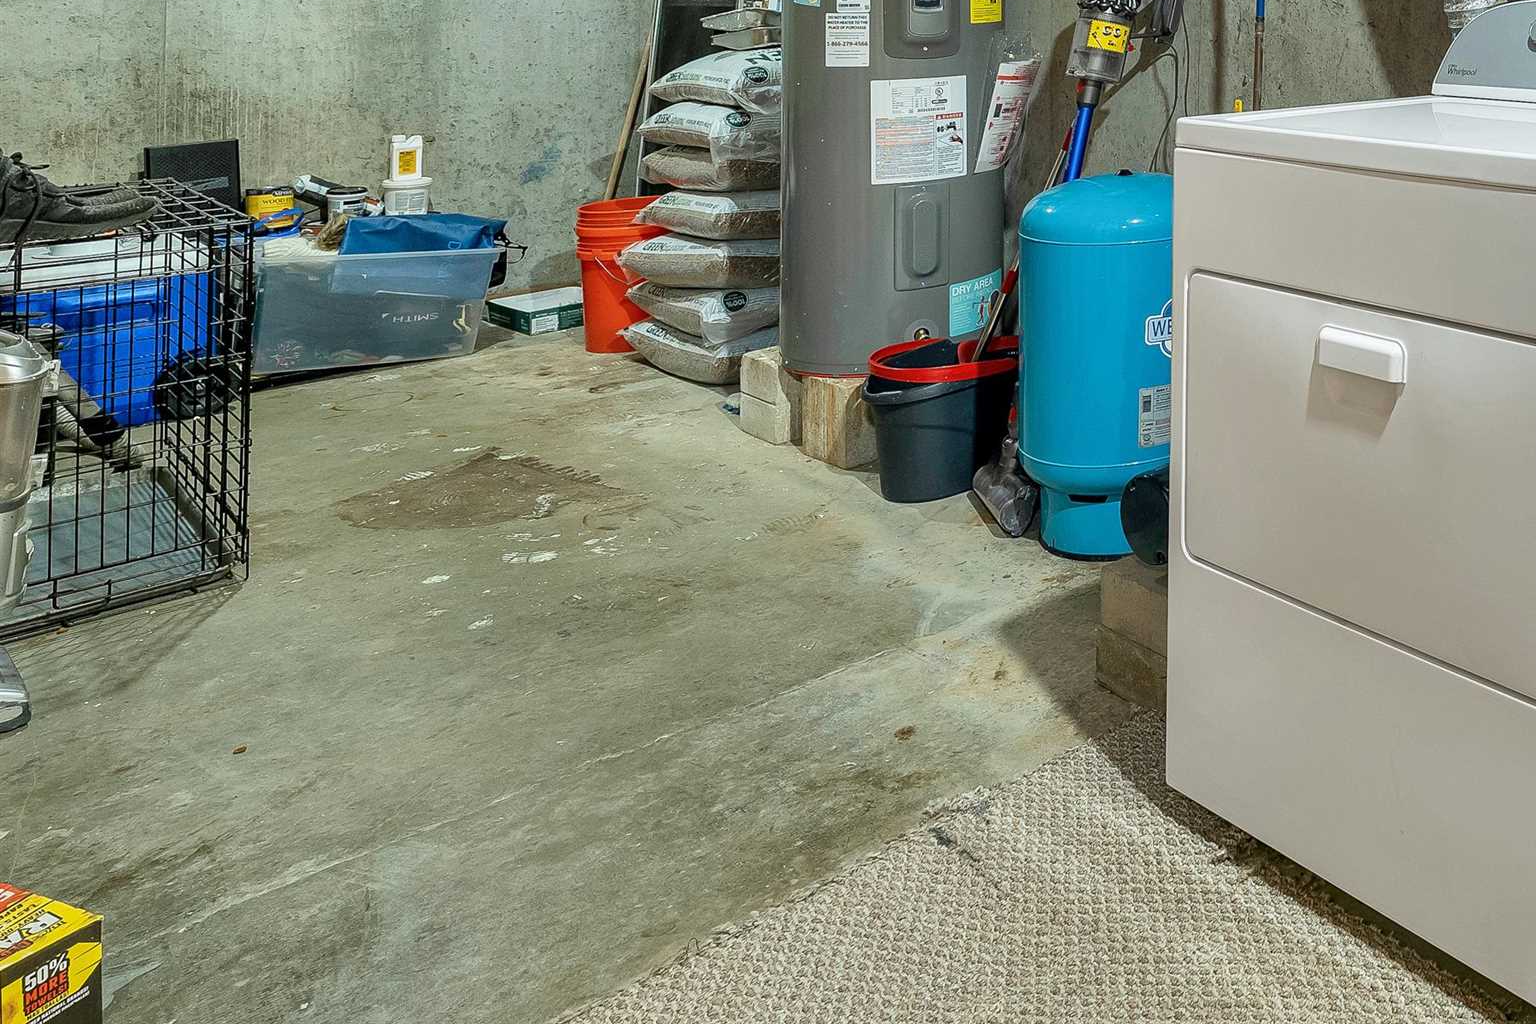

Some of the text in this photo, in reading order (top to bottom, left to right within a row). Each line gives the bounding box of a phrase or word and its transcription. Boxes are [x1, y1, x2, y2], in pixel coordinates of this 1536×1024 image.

[1447, 66, 1477, 76] Whirlpool
[952, 277, 993, 297] DRY AREA
[392, 312, 440, 323] SMITH
[24, 953, 68, 992] 50%
[25, 971, 68, 1004] MORE
[25, 985, 68, 1013] TOWELS!
